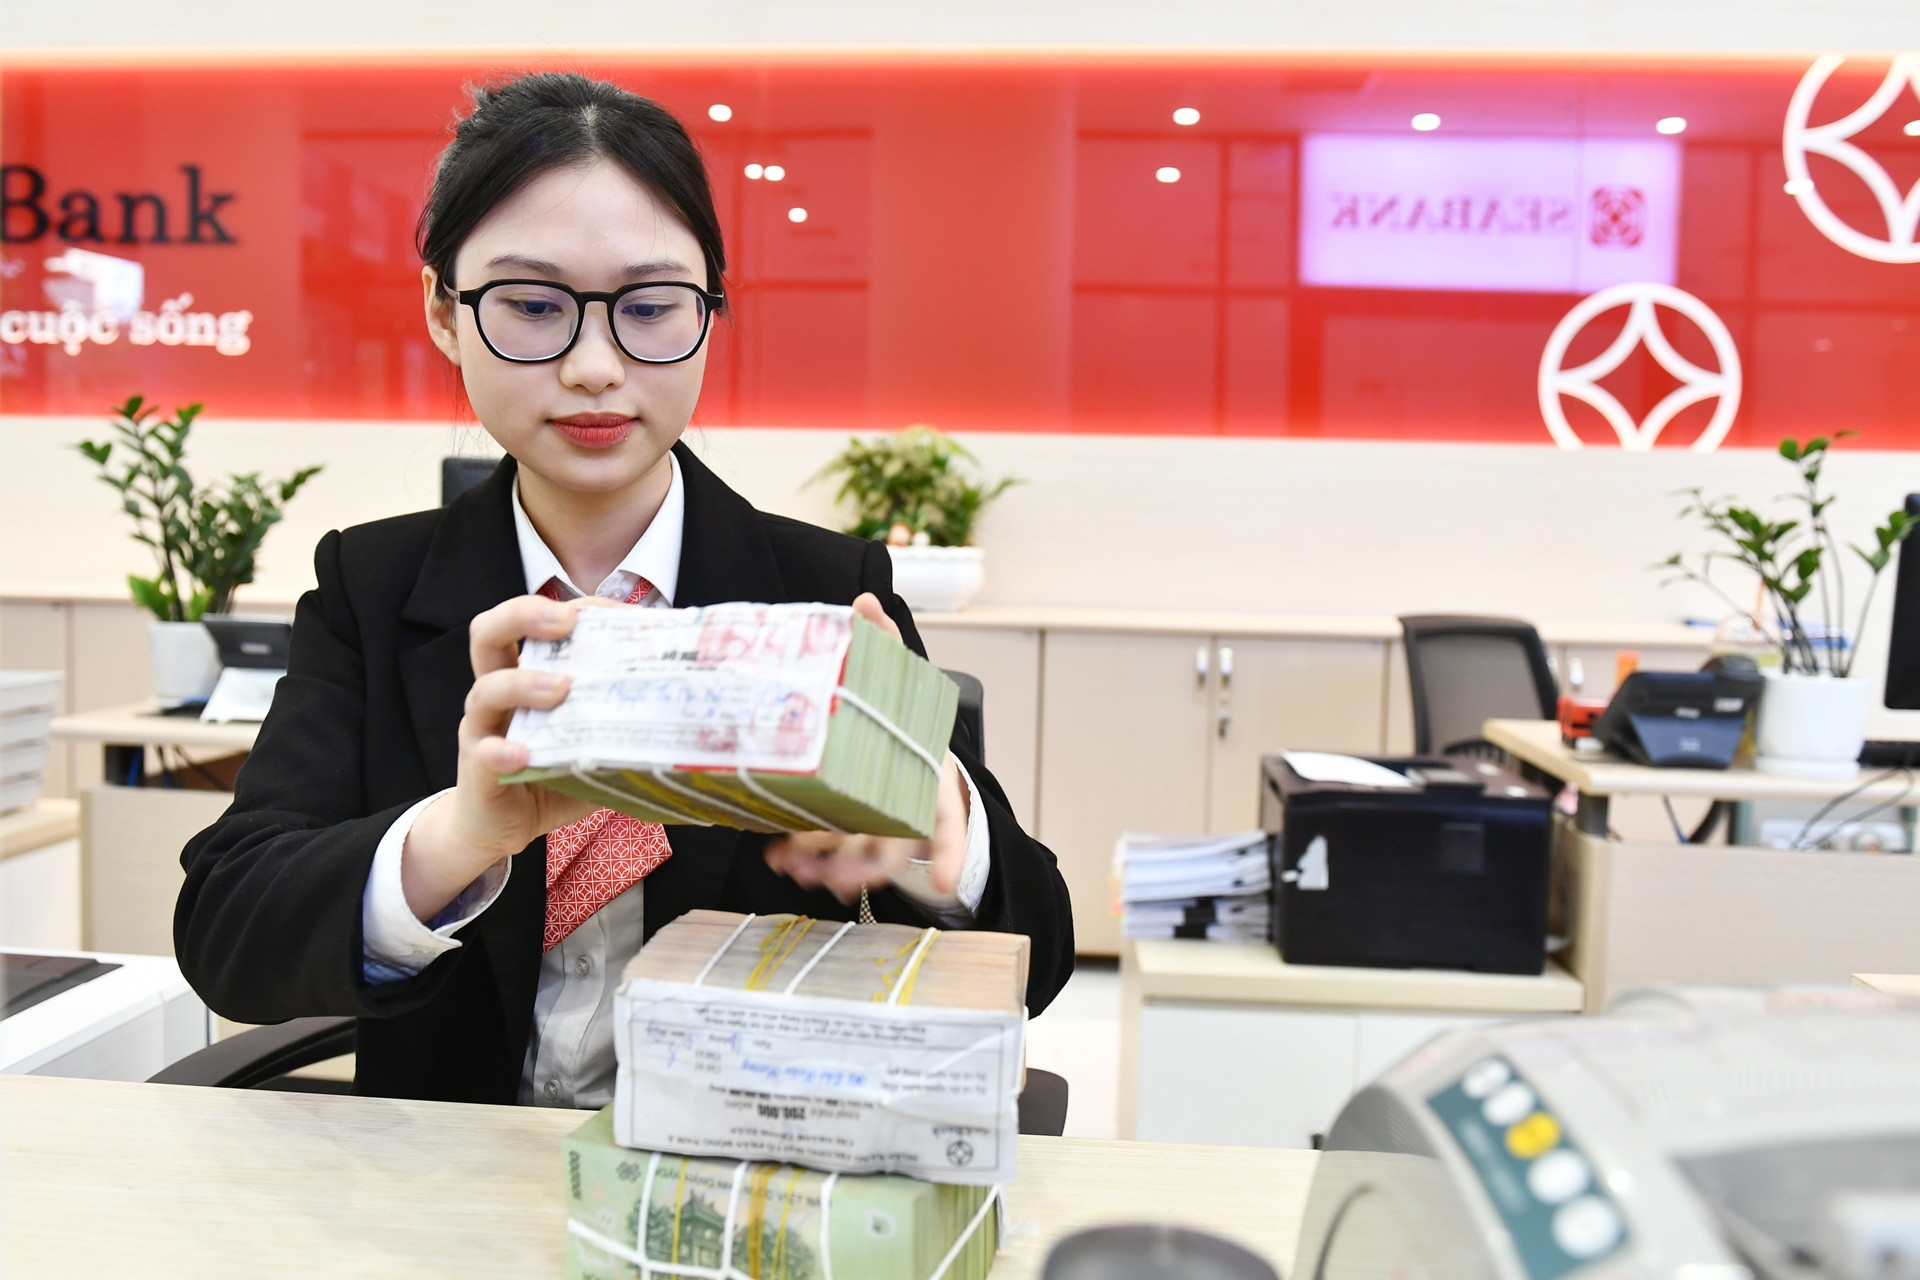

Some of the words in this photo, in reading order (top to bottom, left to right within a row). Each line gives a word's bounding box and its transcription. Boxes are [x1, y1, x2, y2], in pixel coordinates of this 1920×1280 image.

[0, 164, 240, 244] Bank
[0, 299, 119, 356] cuộc
[129, 292, 253, 356] sống
